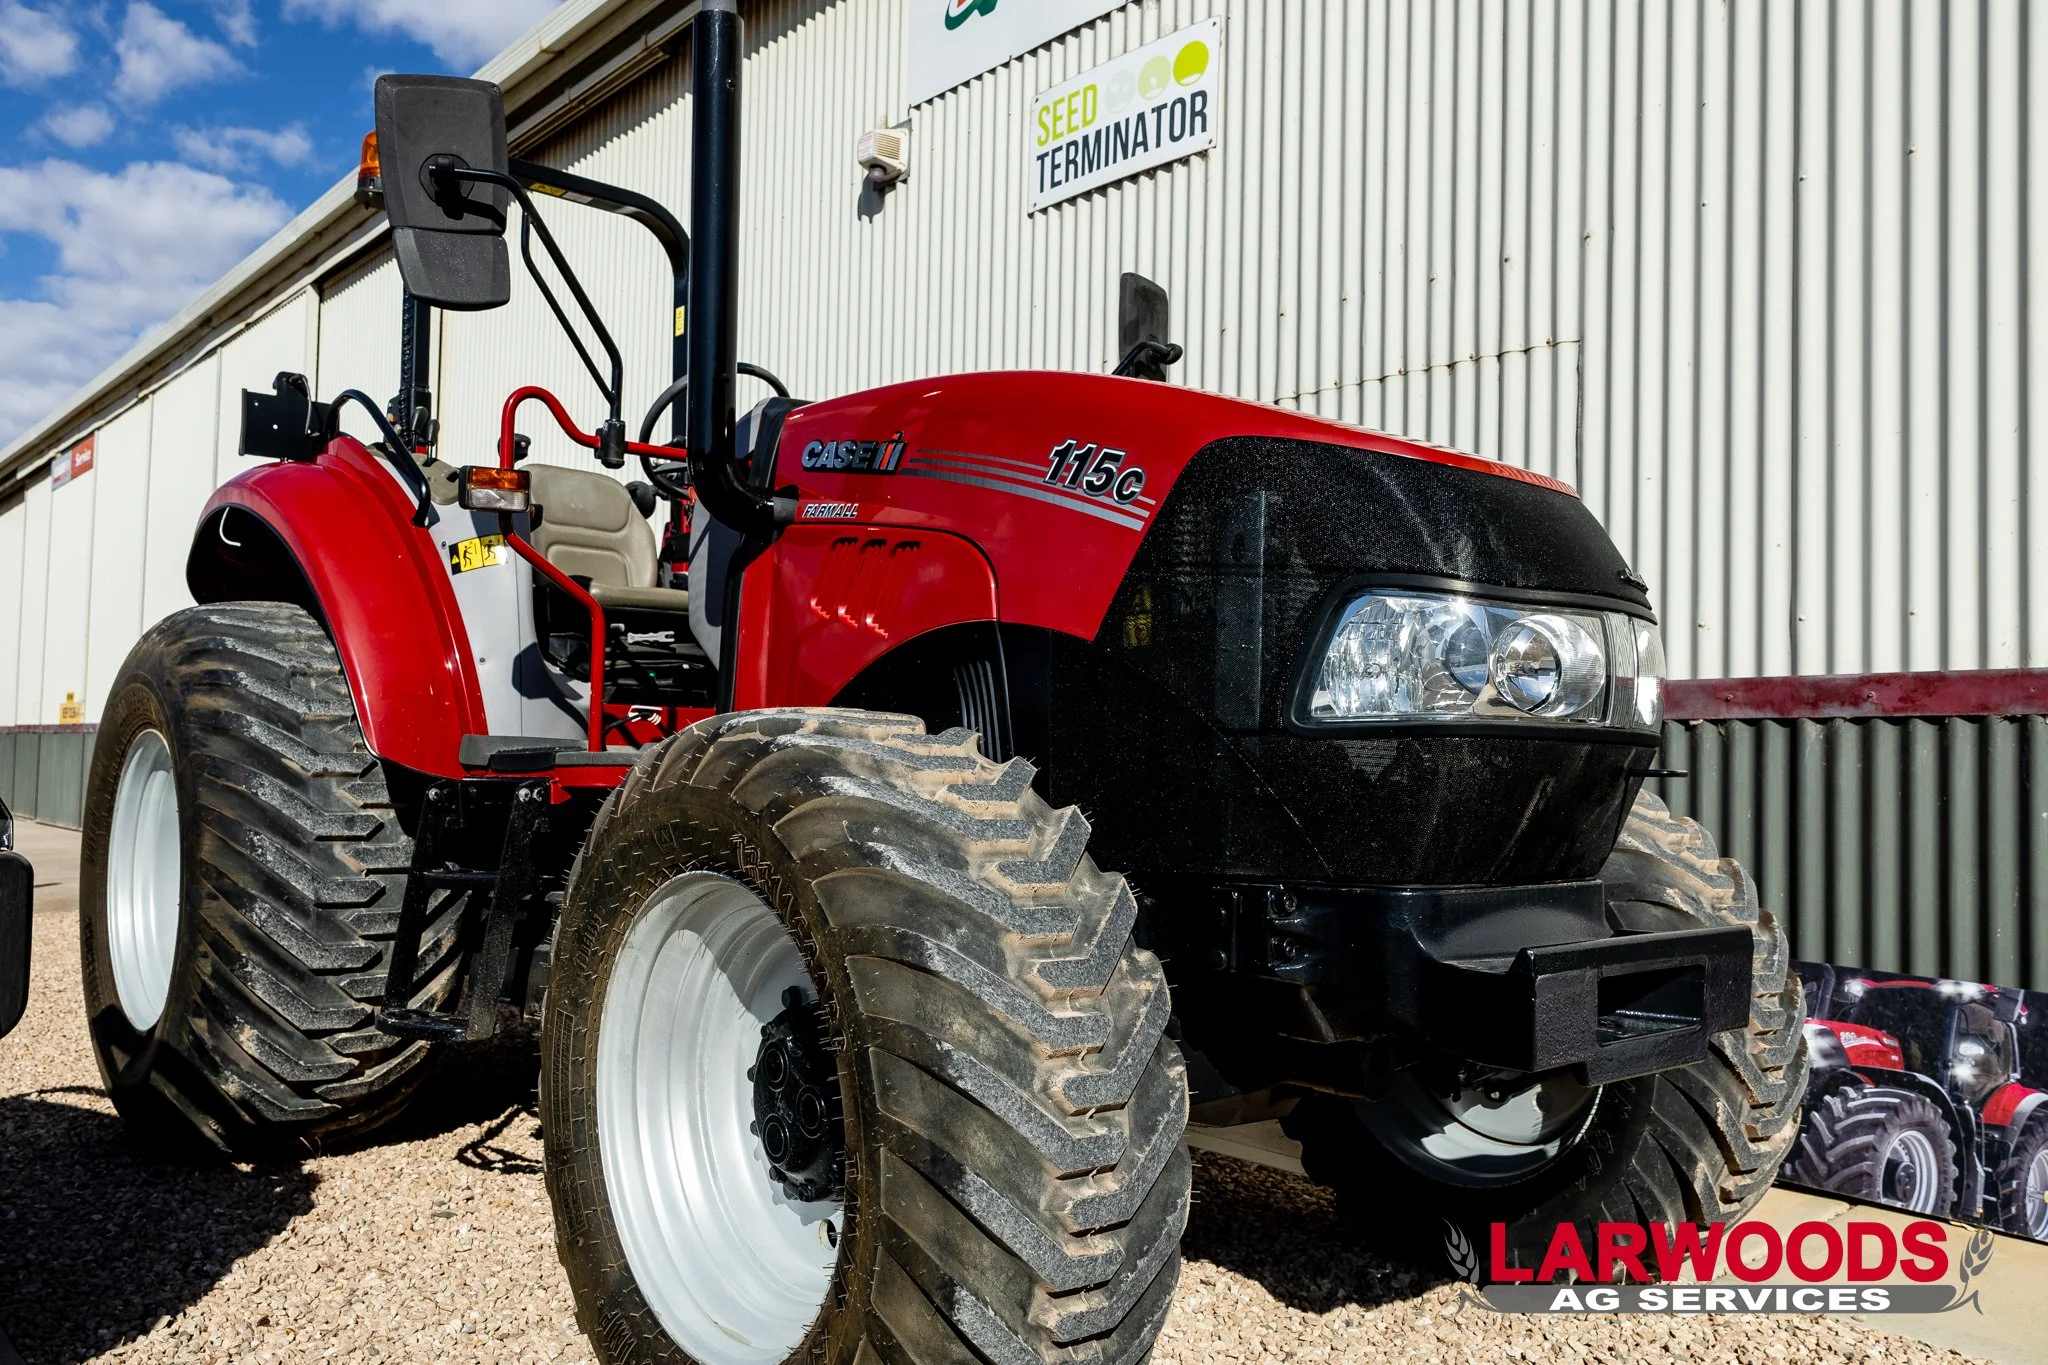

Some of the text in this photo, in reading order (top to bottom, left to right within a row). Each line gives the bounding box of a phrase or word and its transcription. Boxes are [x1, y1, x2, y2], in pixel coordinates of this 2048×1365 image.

[1037, 84, 1097, 147] SEED
[1036, 89, 1208, 194] TERMINATOR
[801, 439, 876, 470] CASE
[802, 503, 859, 519] FARMALL
